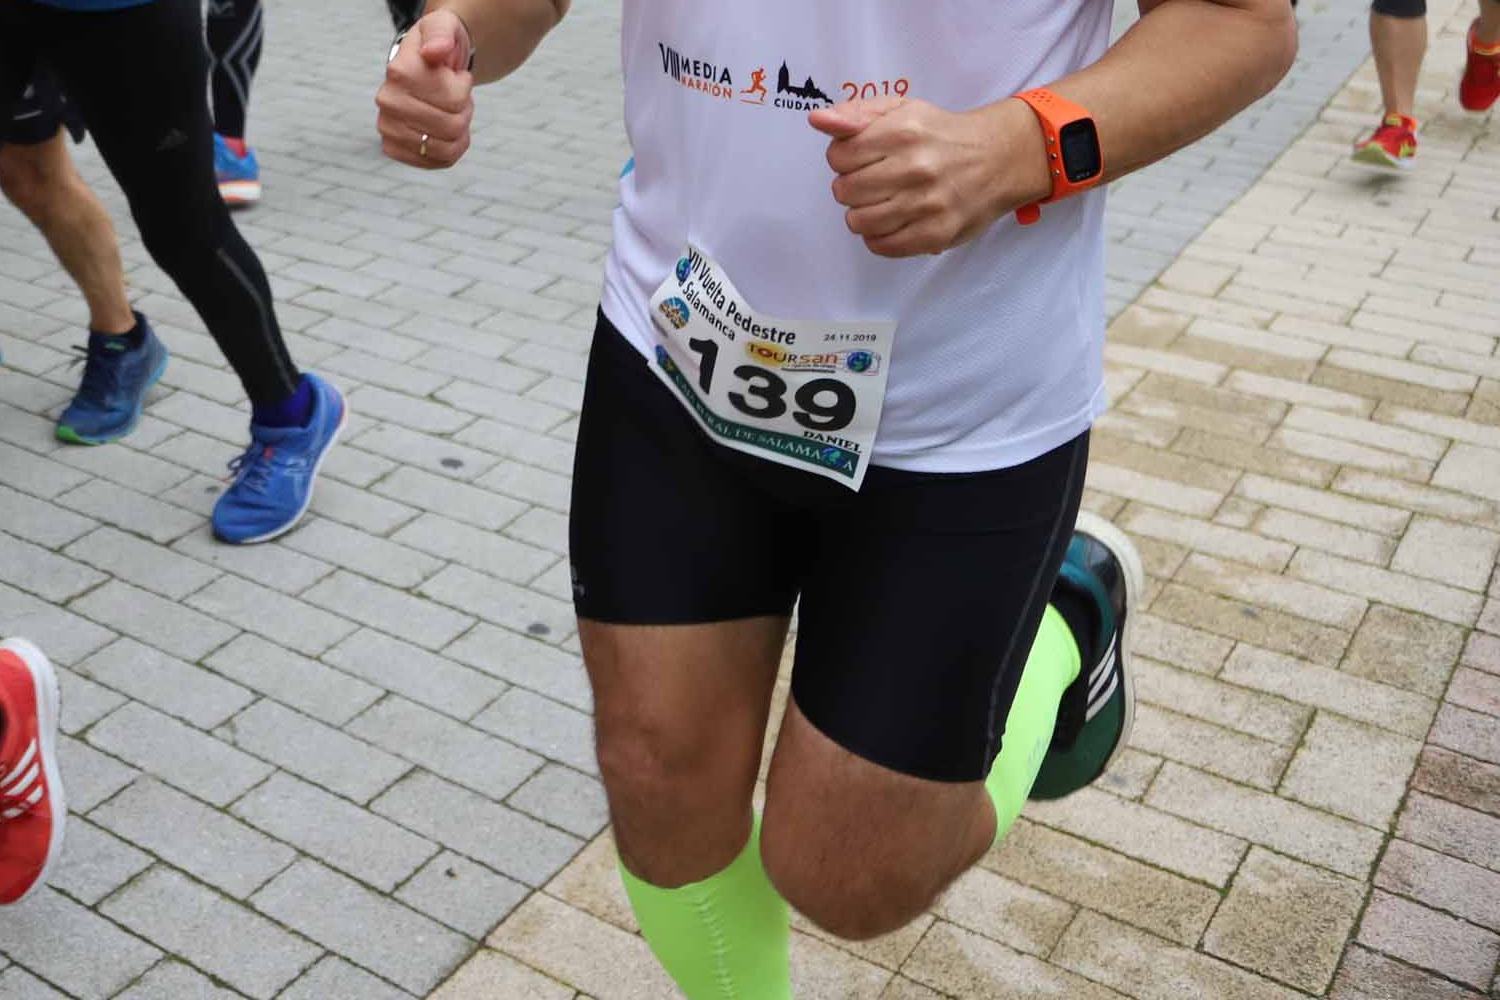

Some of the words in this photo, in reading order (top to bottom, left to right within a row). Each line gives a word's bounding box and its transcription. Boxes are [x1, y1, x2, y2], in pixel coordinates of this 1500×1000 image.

[681, 55, 733, 85] MEDIA
[841, 79, 910, 102] 2019
[681, 280, 736, 342] Salamanca
[698, 260, 726, 311] Vuelta
[726, 300, 797, 346] Pedestre
[688, 337, 857, 432] 139
[757, 434, 854, 473] SALAMAA
[803, 430, 864, 454] DANIEL
